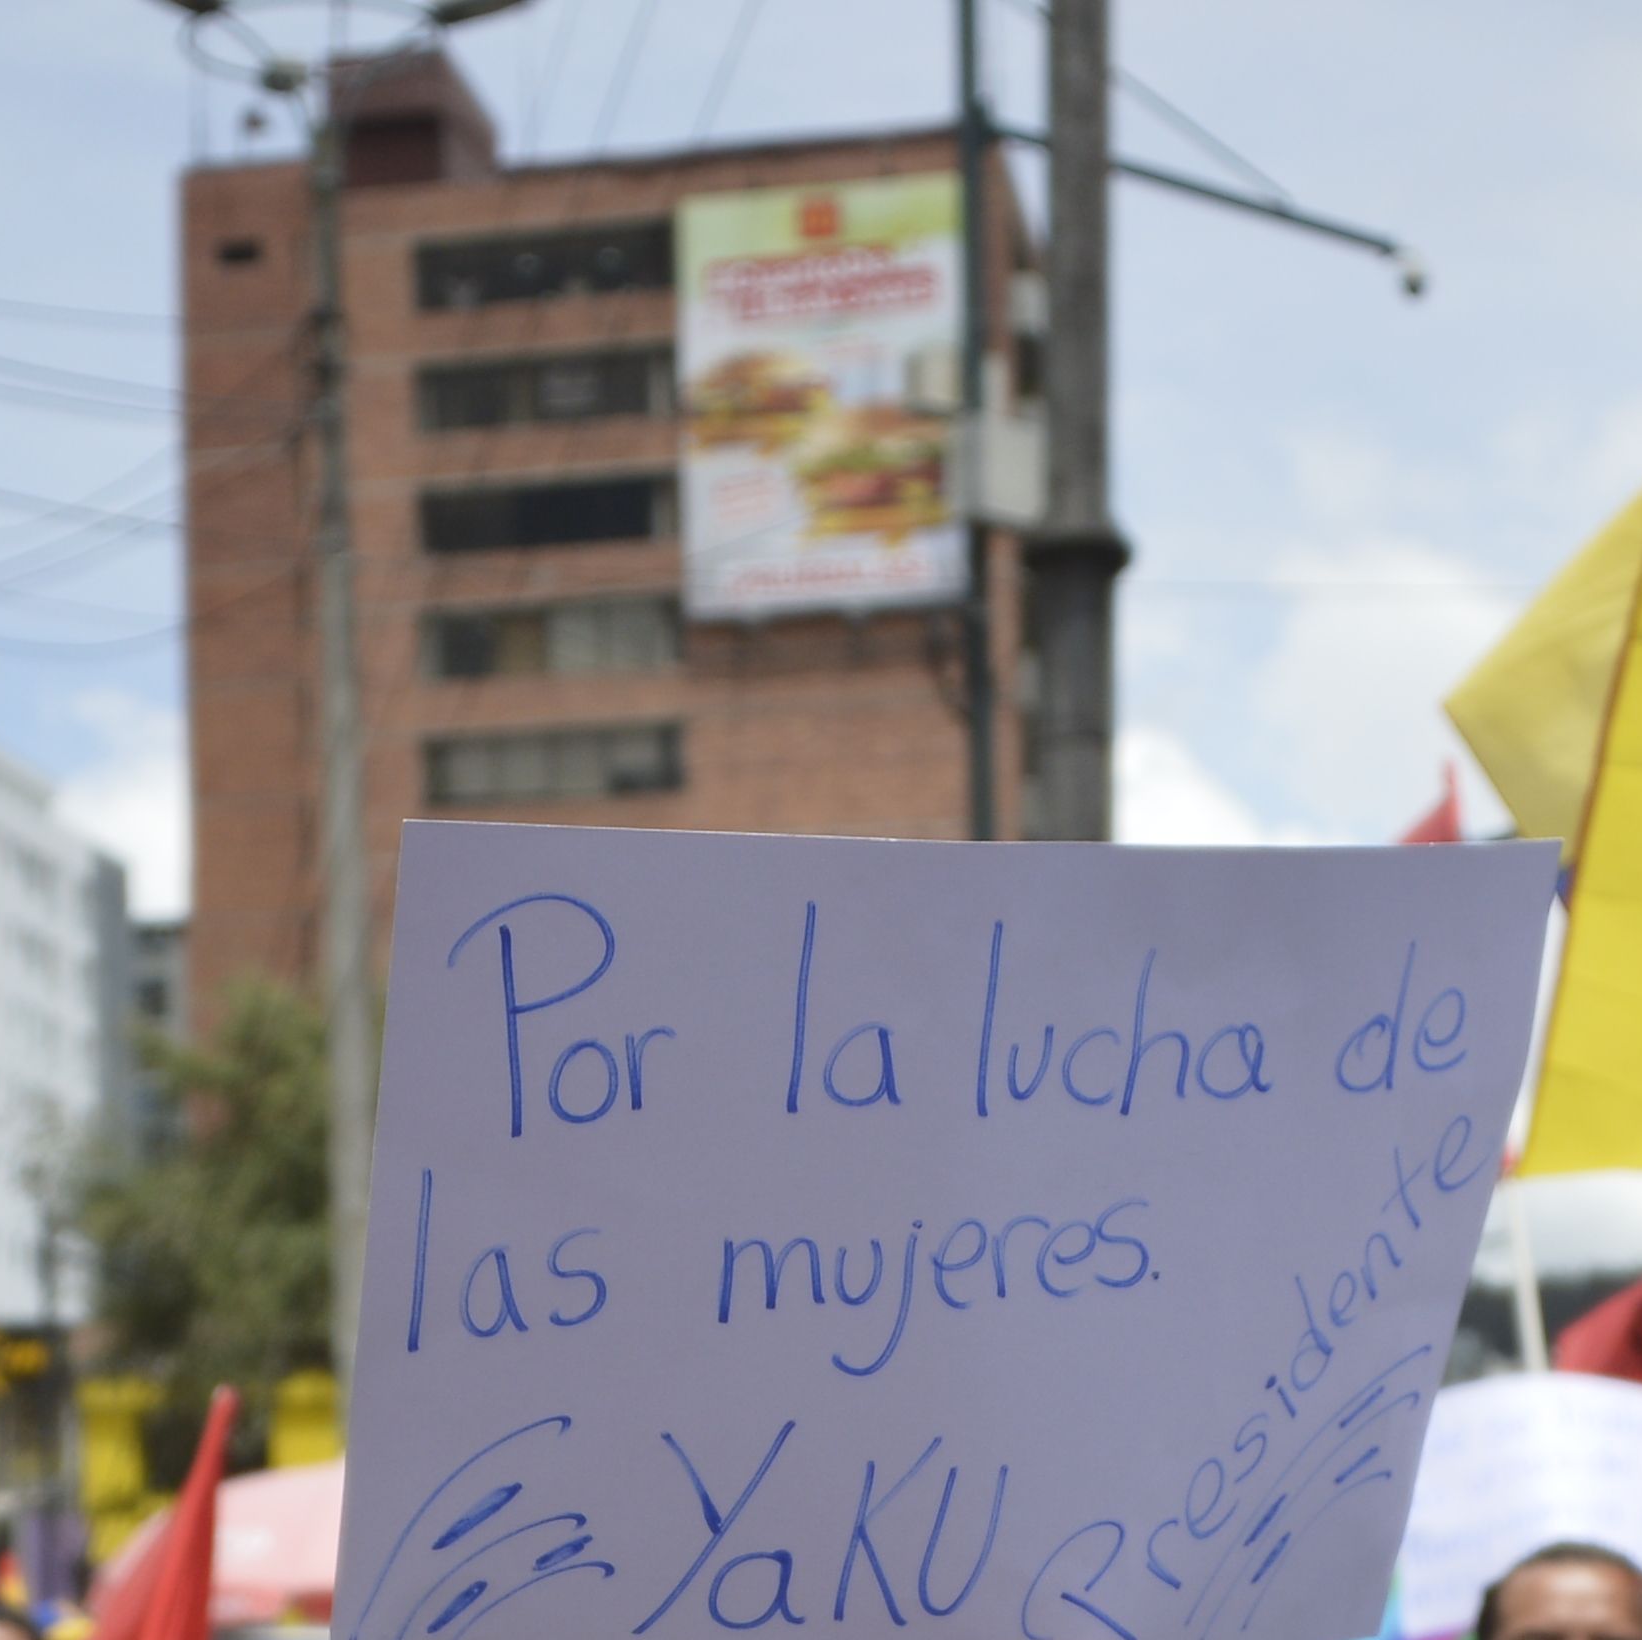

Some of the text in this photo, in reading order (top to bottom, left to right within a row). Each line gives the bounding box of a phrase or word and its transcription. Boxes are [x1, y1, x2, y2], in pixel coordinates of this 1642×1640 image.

[447, 891, 1468, 1138] Por la lucha de
[404, 1166, 1161, 1379] las mujeres.
